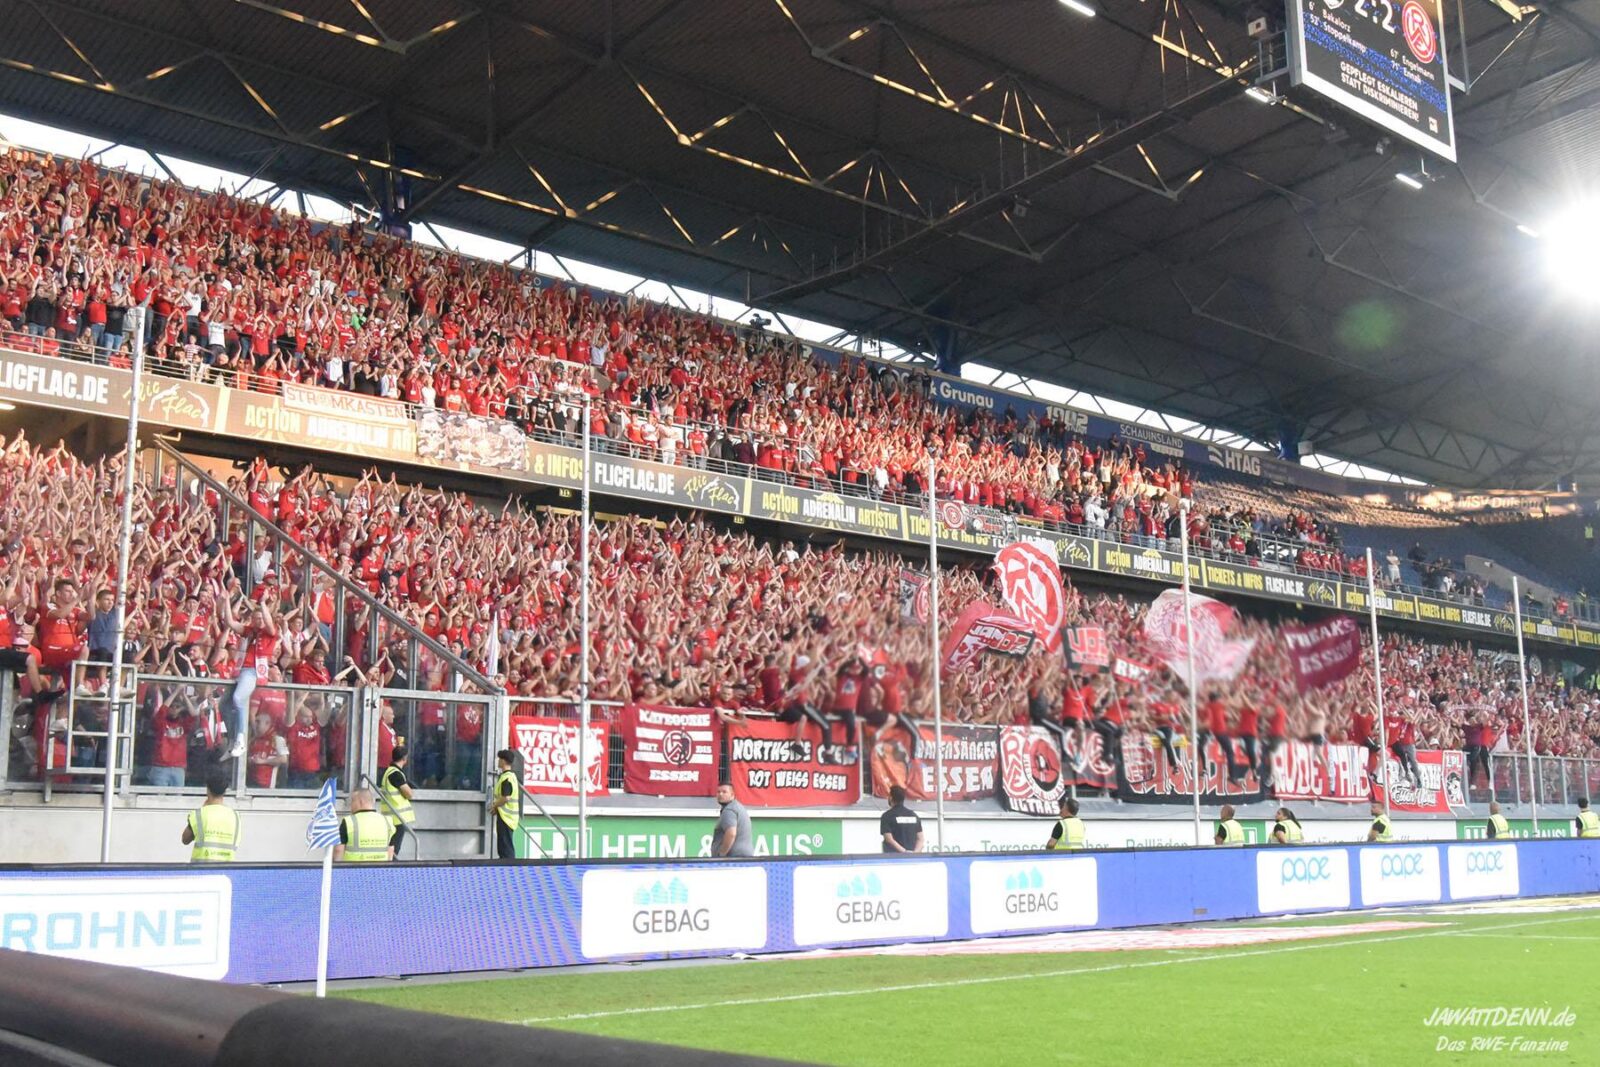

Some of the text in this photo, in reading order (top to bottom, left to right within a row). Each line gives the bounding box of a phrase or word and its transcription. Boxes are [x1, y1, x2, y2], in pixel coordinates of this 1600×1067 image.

[1340, 61, 1418, 111] GEPFLEGT ESKALIEREN
[1341, 72, 1361, 90] STATT
[940, 382, 994, 408] Grunau
[245, 402, 300, 434] ACTION
[1120, 424, 1184, 449] SCHAUINSLAND
[1225, 450, 1261, 476] HTAG
[595, 461, 675, 495] FLICFLAC.DE
[762, 490, 798, 514] ACTION
[802, 498, 857, 524] ADRENALIN
[858, 507, 899, 530] ARTISTIK
[1106, 550, 1131, 568] ACTION
[1133, 554, 1170, 574] ADRENALIN
[1207, 566, 1235, 586] TICKETS
[1243, 572, 1264, 591] INFOS
[1265, 576, 1305, 597] FLICFLAC.DE
[748, 769, 847, 791] ROT WEISS ESSEN
[1009, 798, 1061, 814] ULTRAS
[602, 834, 686, 857] HEIM
[1282, 849, 1504, 886] pape pape pape
[632, 892, 1059, 934] GEBAG GEBAG GEBAG
